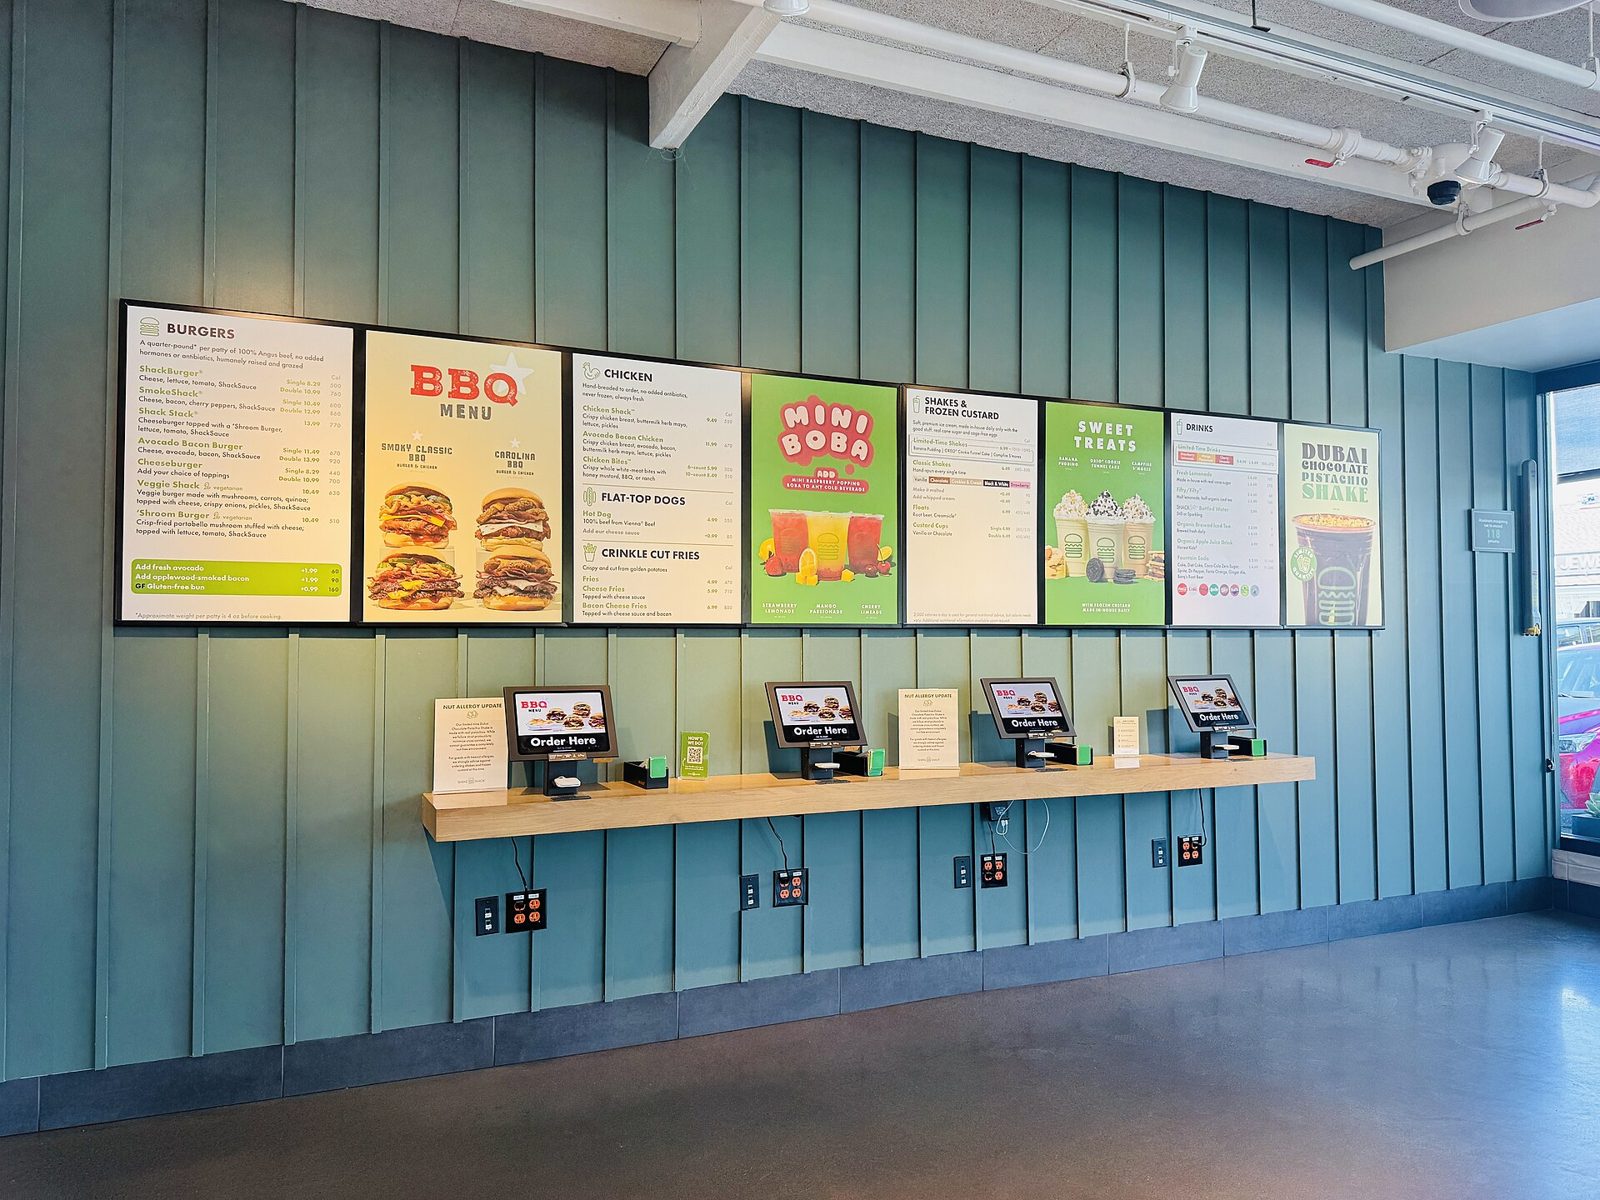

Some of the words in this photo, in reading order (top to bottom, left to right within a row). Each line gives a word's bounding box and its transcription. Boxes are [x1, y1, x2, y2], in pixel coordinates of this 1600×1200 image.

[167, 323, 235, 339] BURGERS
[604, 369, 653, 382] CHICKEN
[139, 375, 164, 383] Cheese,
[167, 377, 189, 385] lettuce,
[192, 380, 216, 388] tomato,
[218, 381, 256, 390] ShackSauce
[411, 364, 518, 407] BBQ
[139, 396, 162, 405] Cheese,
[189, 400, 209, 409] cherry
[211, 402, 237, 411] peppers,
[239, 403, 275, 412] ShackSauce
[925, 397, 958, 407] SHAKES
[961, 400, 967, 408] &
[139, 407, 166, 416] Shack
[440, 404, 492, 420] MENU
[583, 405, 609, 413] Chicken
[925, 407, 959, 416] FROZEN
[962, 409, 999, 420] CUSTARD
[785, 405, 868, 434] MINI
[1079, 421, 1133, 436] SWEET
[1186, 423, 1213, 432] DRINKS
[583, 431, 614, 439] Avocado
[616, 433, 636, 441] Bacon
[638, 434, 663, 443] Chicken
[913, 438, 947, 446] Limited-Time
[138, 437, 179, 446] Avocado
[182, 440, 210, 448] Bacon
[212, 441, 243, 451] Burger
[382, 443, 412, 452] SMOKY
[416, 445, 453, 455] CLASSIC
[782, 430, 868, 460] BOBA
[1074, 436, 1136, 452] TREATS
[137, 446, 163, 455] Cheese,
[166, 449, 196, 457] avocado,
[199, 451, 220, 459] bacon,
[223, 451, 260, 460] ShackSauce
[283, 447, 301, 455] Single
[495, 451, 536, 461] CAROLINA
[1302, 443, 1367, 465] DUBAI
[137, 459, 203, 469] Cheeseburger
[409, 454, 426, 462] BBQ
[583, 456, 610, 464] Chicken
[1302, 461, 1368, 475] CHOCOLATE
[137, 479, 170, 489] Veggie
[173, 481, 199, 489] Shack
[1302, 472, 1368, 486] PISTACHIO
[1302, 483, 1368, 503] SHAKE
[602, 493, 651, 504] FLAT-TOP
[654, 495, 685, 506] DOGS
[178, 511, 209, 520] Burger
[602, 549, 648, 558] CRINKLE
[650, 550, 670, 559] CUT
[673, 551, 699, 560] FRIES
[153, 574, 226, 583] applewood-smoked
[521, 700, 547, 709] BBQ
[1200, 713, 1221, 721] Order
[1012, 719, 1036, 728] Order
[1038, 719, 1058, 727] Here
[794, 727, 822, 736] Order
[531, 737, 565, 747] Order
[568, 736, 596, 745] Here
